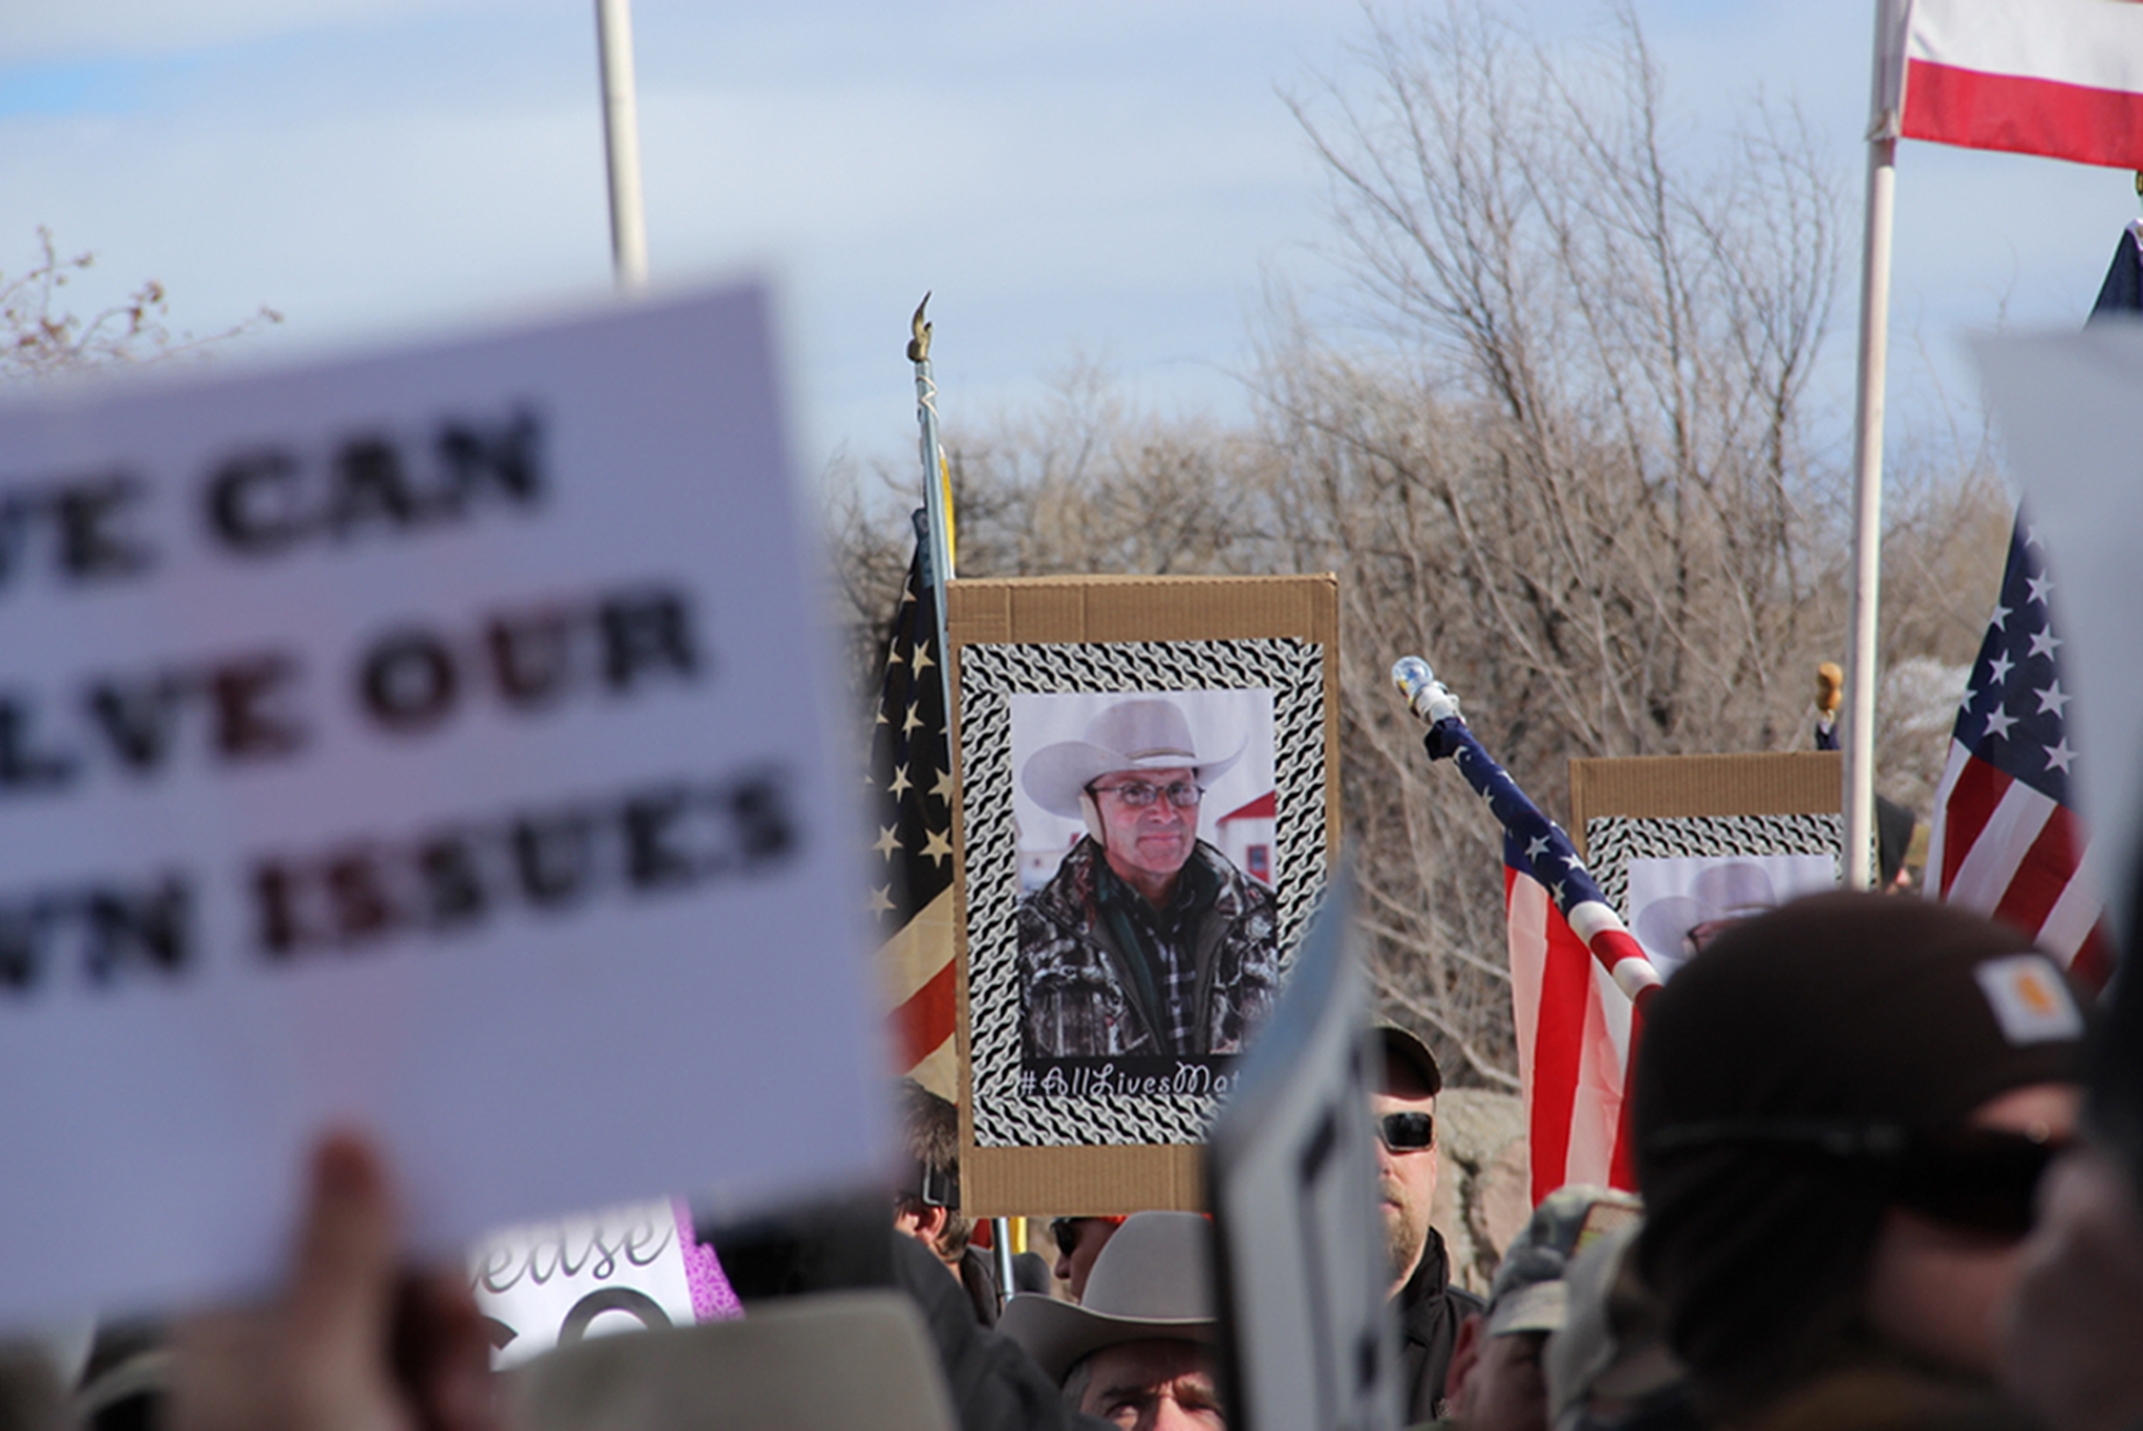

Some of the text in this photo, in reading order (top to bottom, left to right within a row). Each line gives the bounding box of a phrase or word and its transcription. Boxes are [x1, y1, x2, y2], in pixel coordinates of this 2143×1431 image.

[203, 396, 552, 562] CAN
[354, 578, 704, 735] OUR
[246, 758, 803, 962] ISSUES
